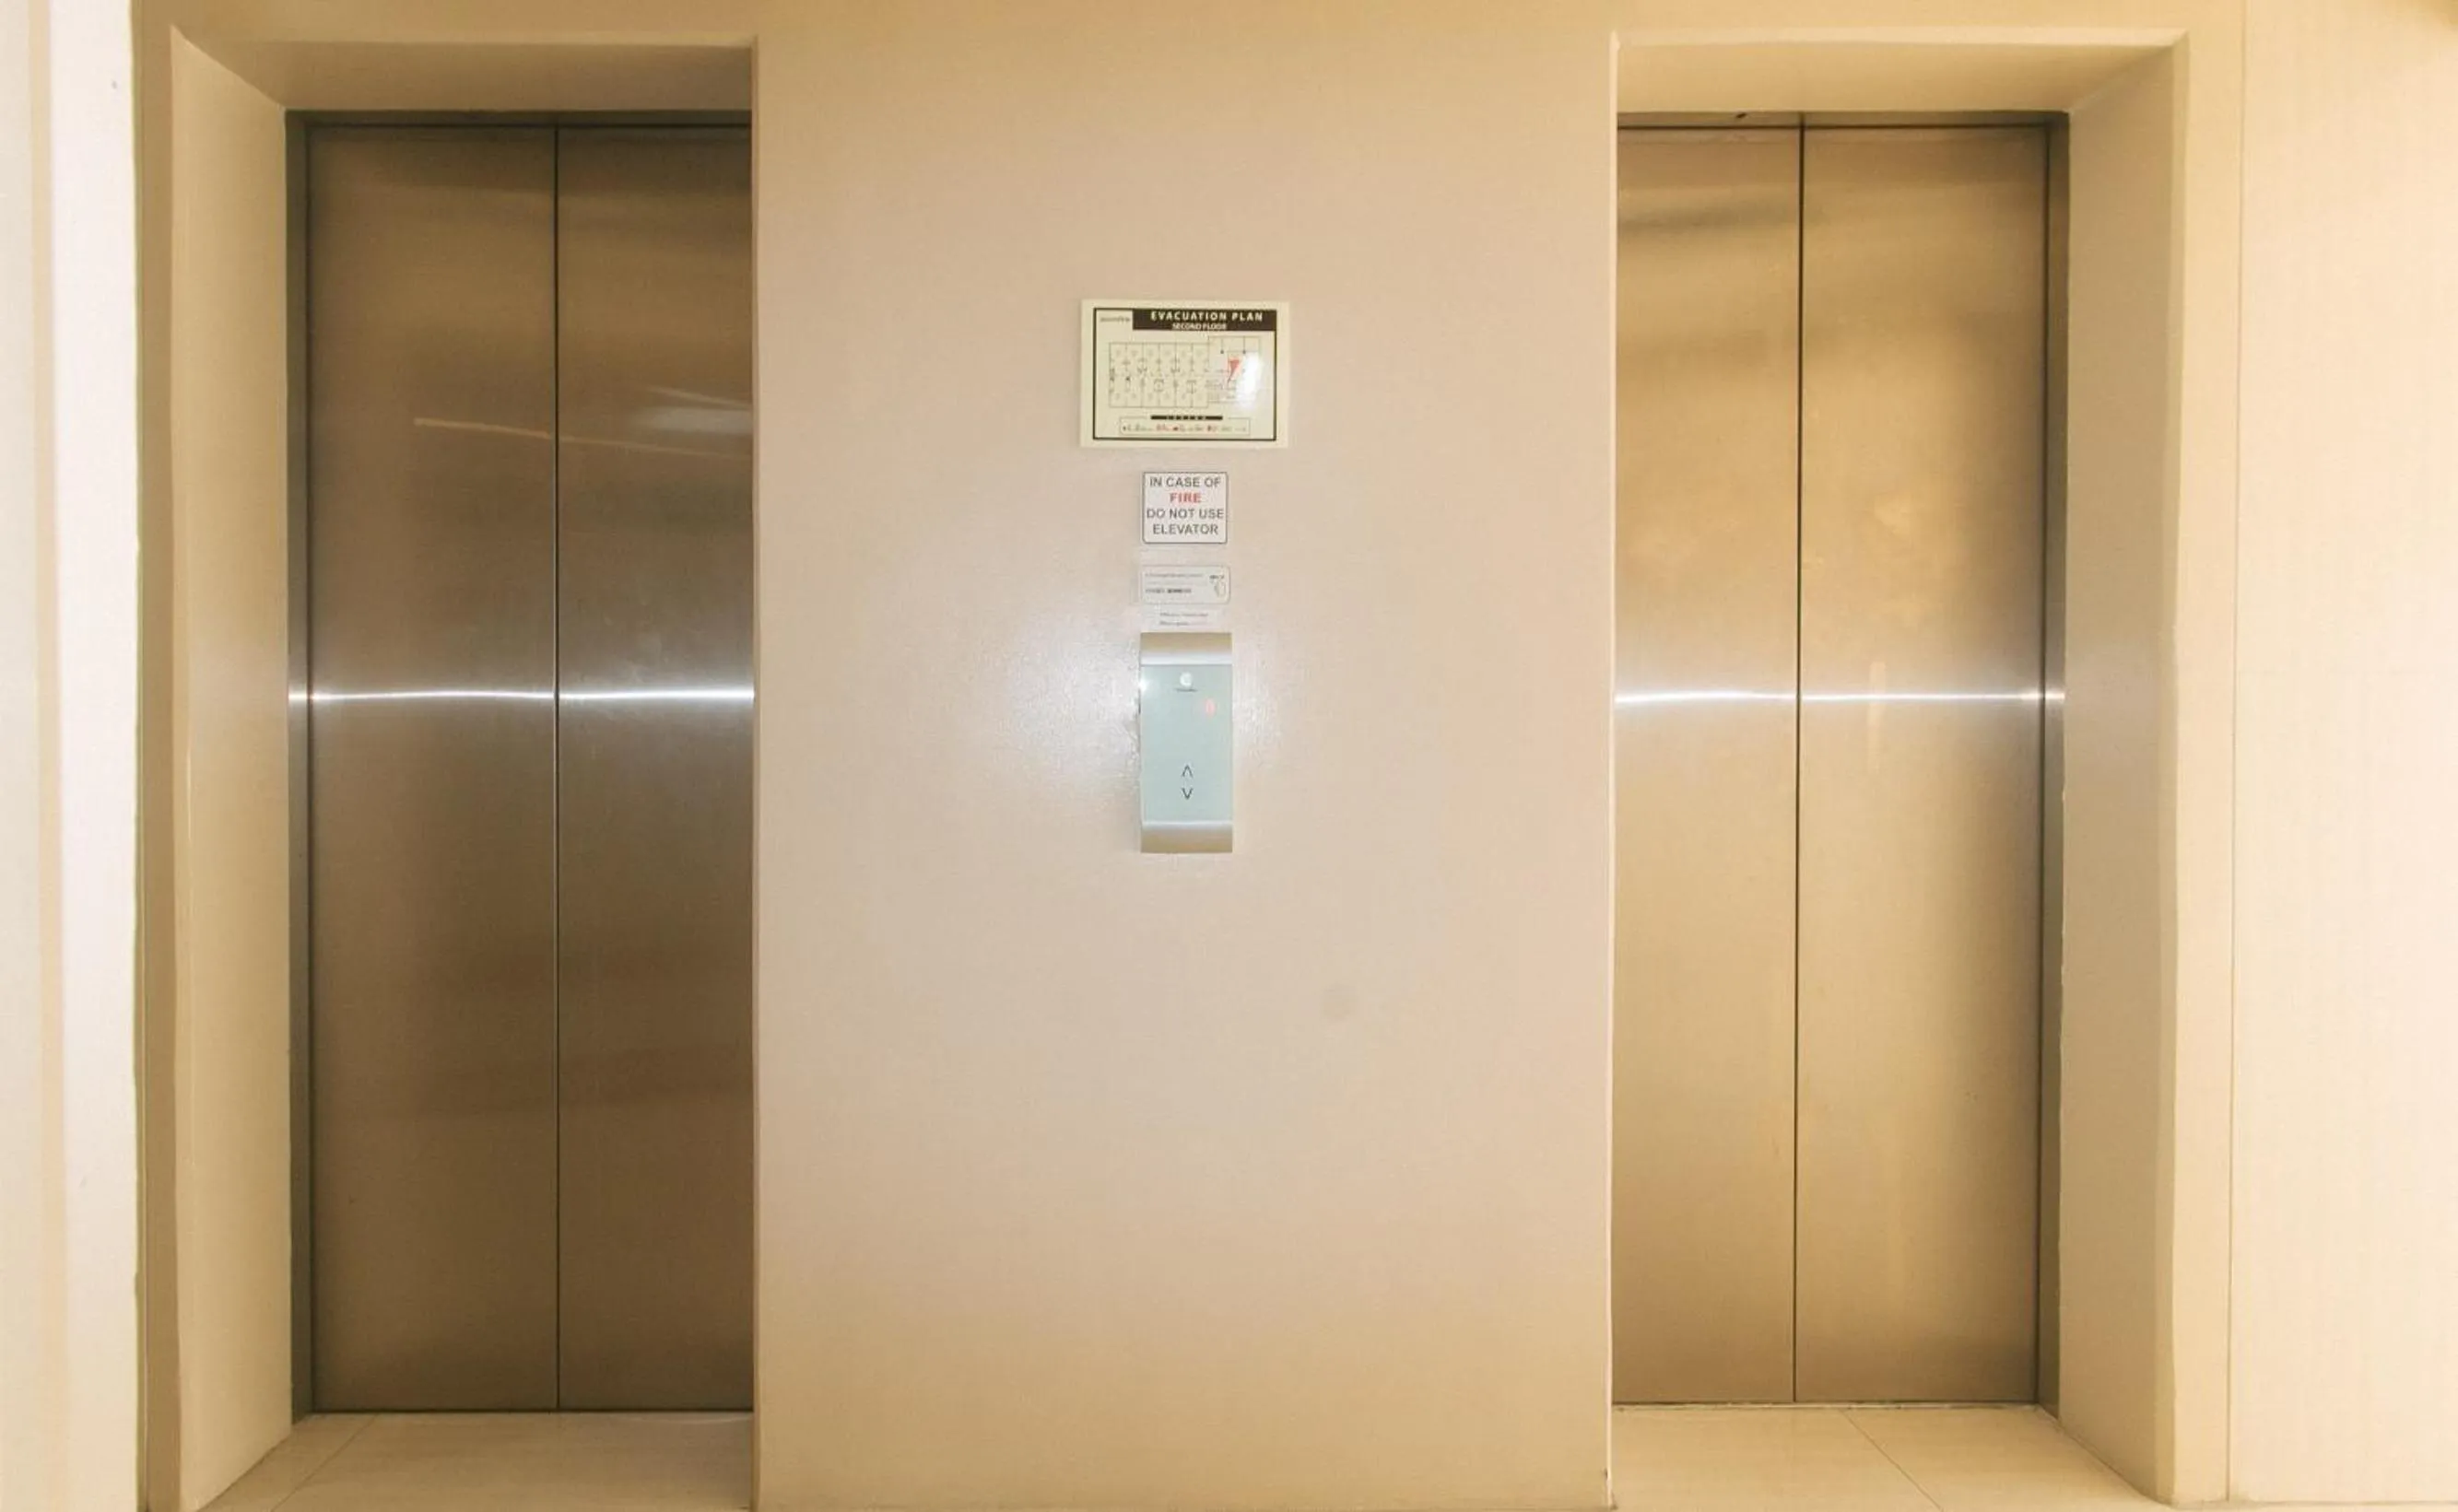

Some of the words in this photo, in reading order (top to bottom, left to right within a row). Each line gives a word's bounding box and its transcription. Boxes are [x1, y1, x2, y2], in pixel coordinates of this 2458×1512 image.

[1150, 311, 1227, 322] EVACUATION
[1231, 311, 1263, 322] PLAN
[1149, 476, 1162, 487] IN
[1166, 476, 1200, 487] CASE
[1204, 476, 1221, 487] OF
[1170, 492, 1202, 503] FIRE
[1147, 508, 1165, 519] DO
[1170, 508, 1195, 519] NOT
[1199, 508, 1224, 519] USE
[1152, 523, 1218, 534] ELEVATOR
